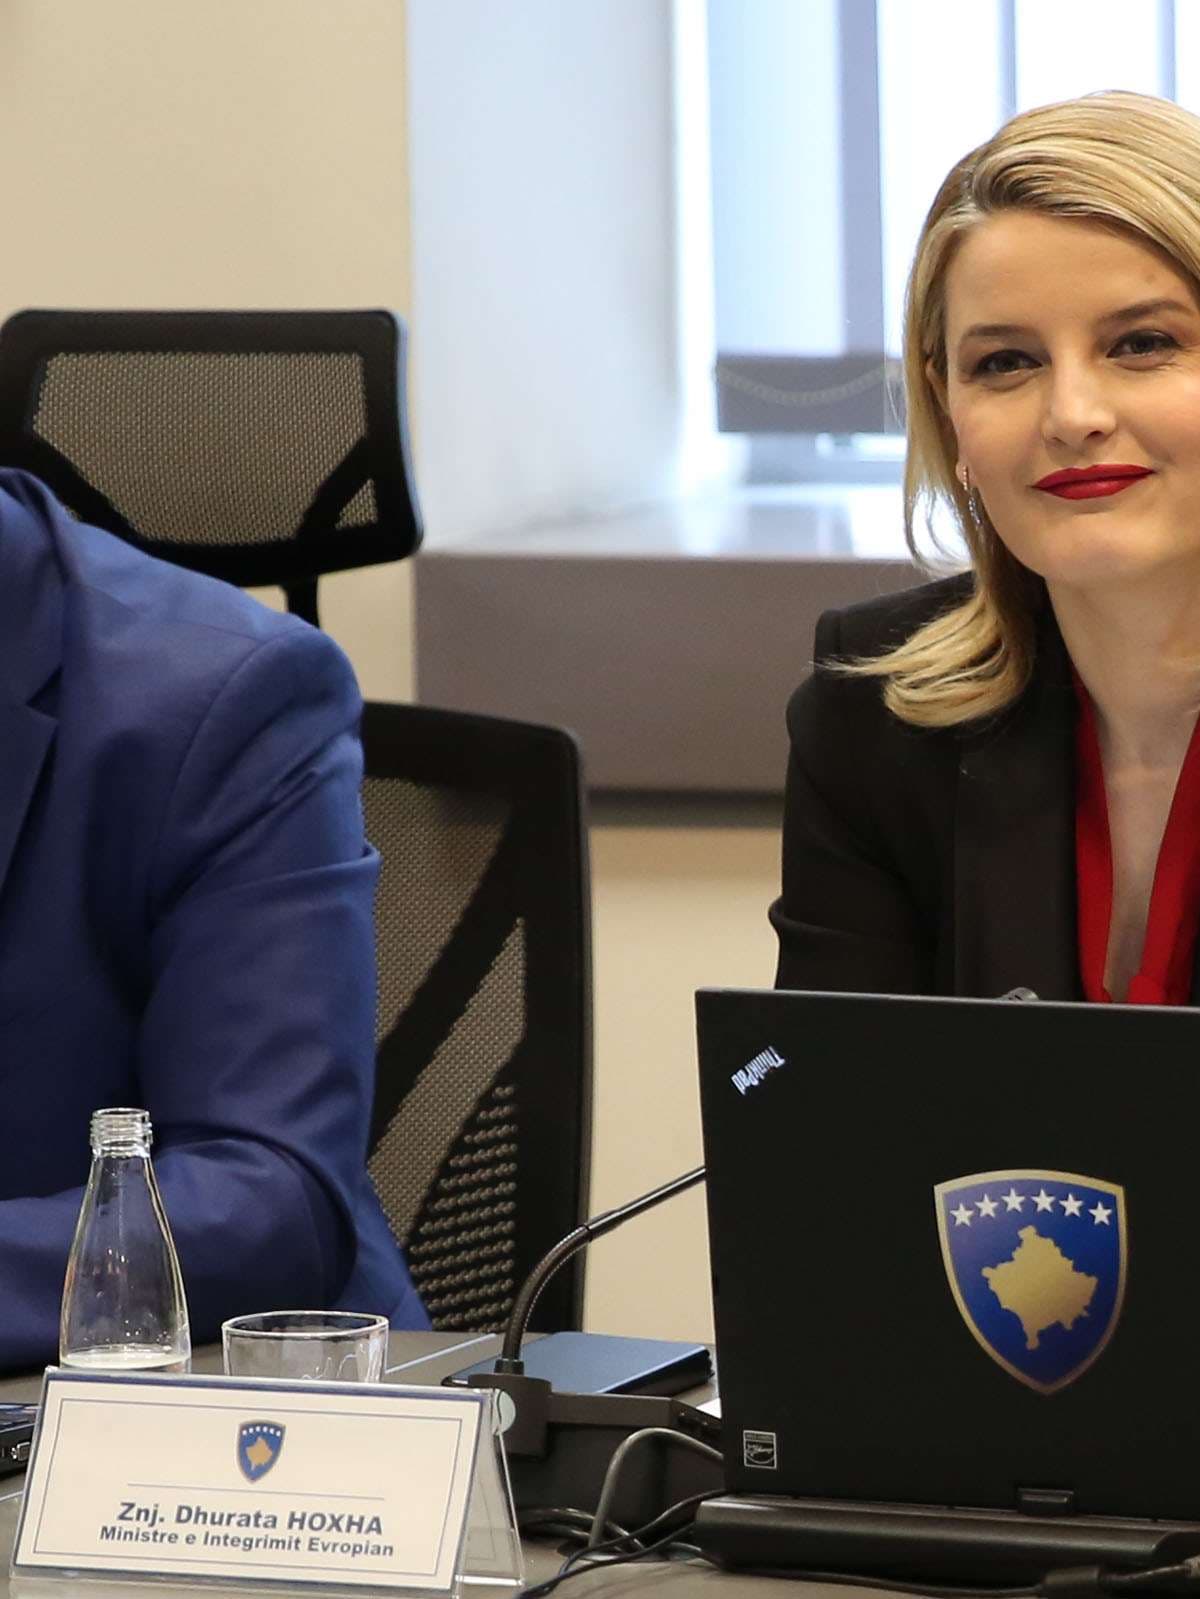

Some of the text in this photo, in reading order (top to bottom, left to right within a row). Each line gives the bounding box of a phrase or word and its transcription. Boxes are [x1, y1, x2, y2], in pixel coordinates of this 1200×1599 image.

[731, 1045, 785, 1096] ThinkPad
[117, 1501, 383, 1535] Znj. Dhurata HOXHA
[100, 1525, 394, 1558] Ministre e Integrimit Evropian
